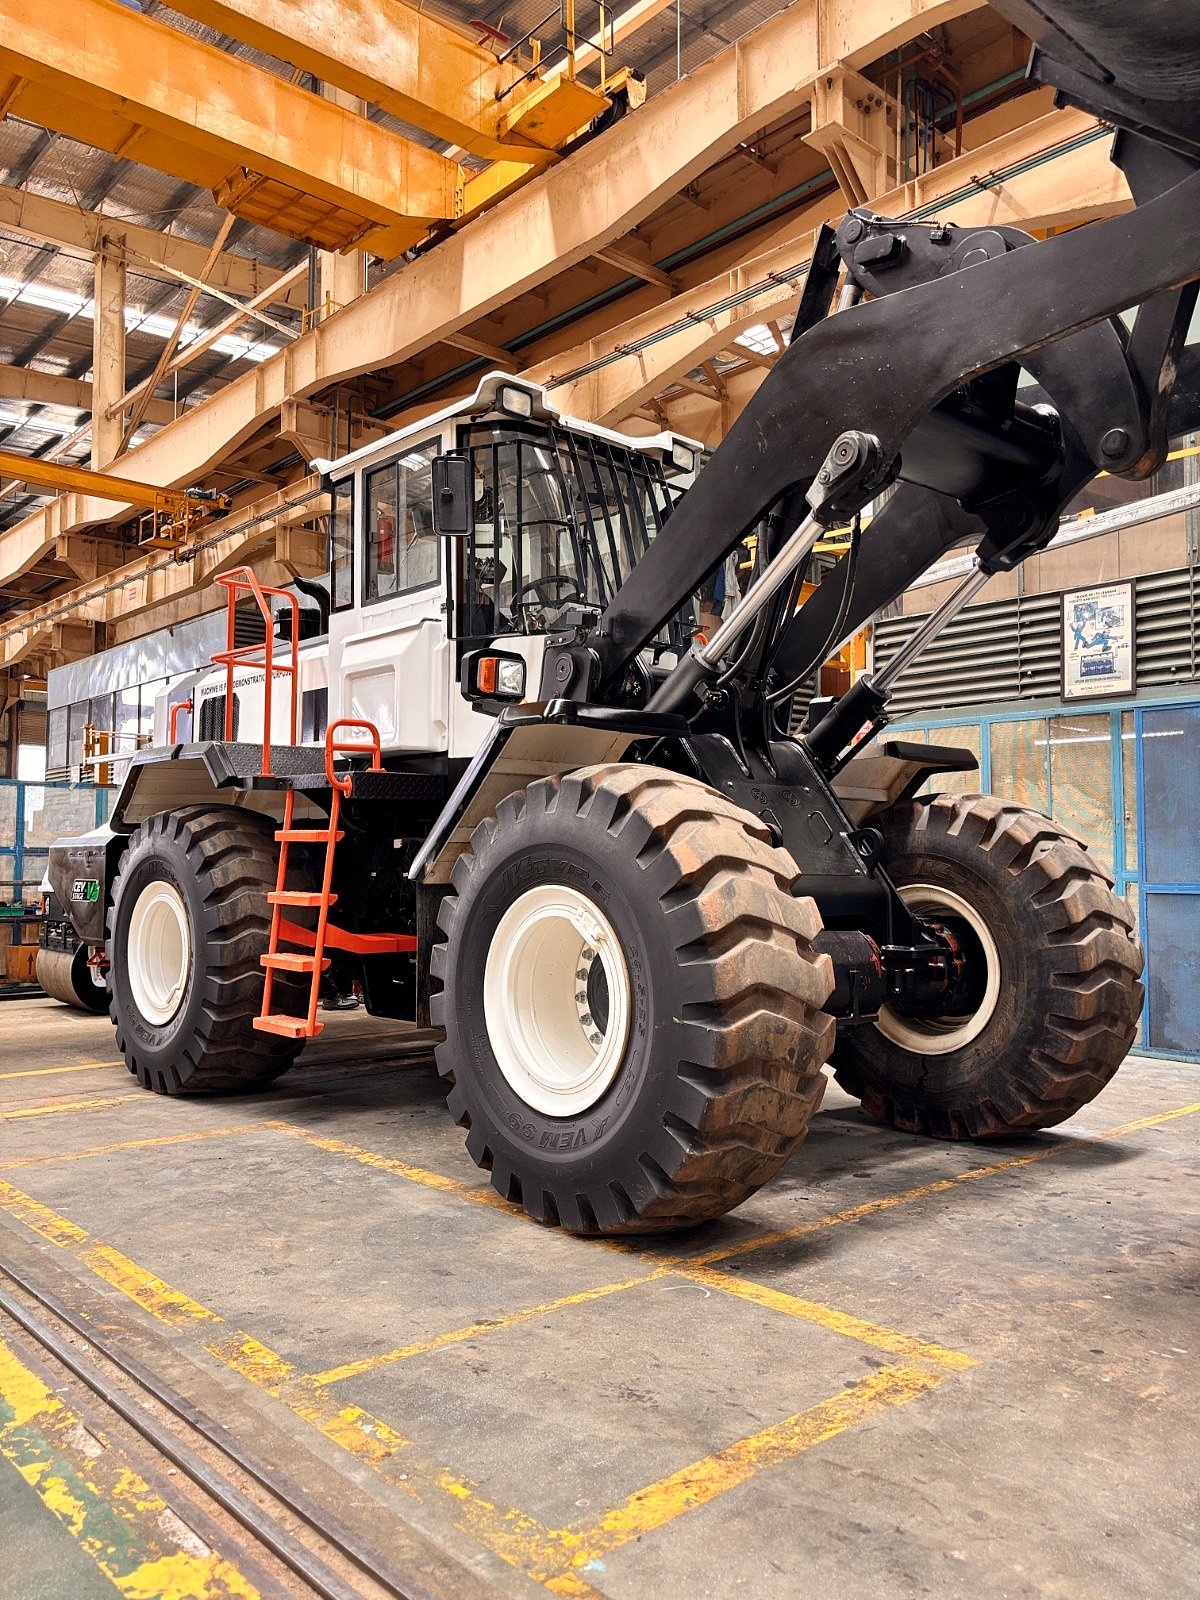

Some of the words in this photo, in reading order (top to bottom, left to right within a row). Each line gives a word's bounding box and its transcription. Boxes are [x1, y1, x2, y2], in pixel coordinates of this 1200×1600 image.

[201, 685, 218, 696] MACHINE
[219, 683, 224, 692] IS
[233, 674, 266, 689] DEMONSTRATIO
[74, 881, 86, 892] CEV
[538, 1127, 588, 1151] VEM
